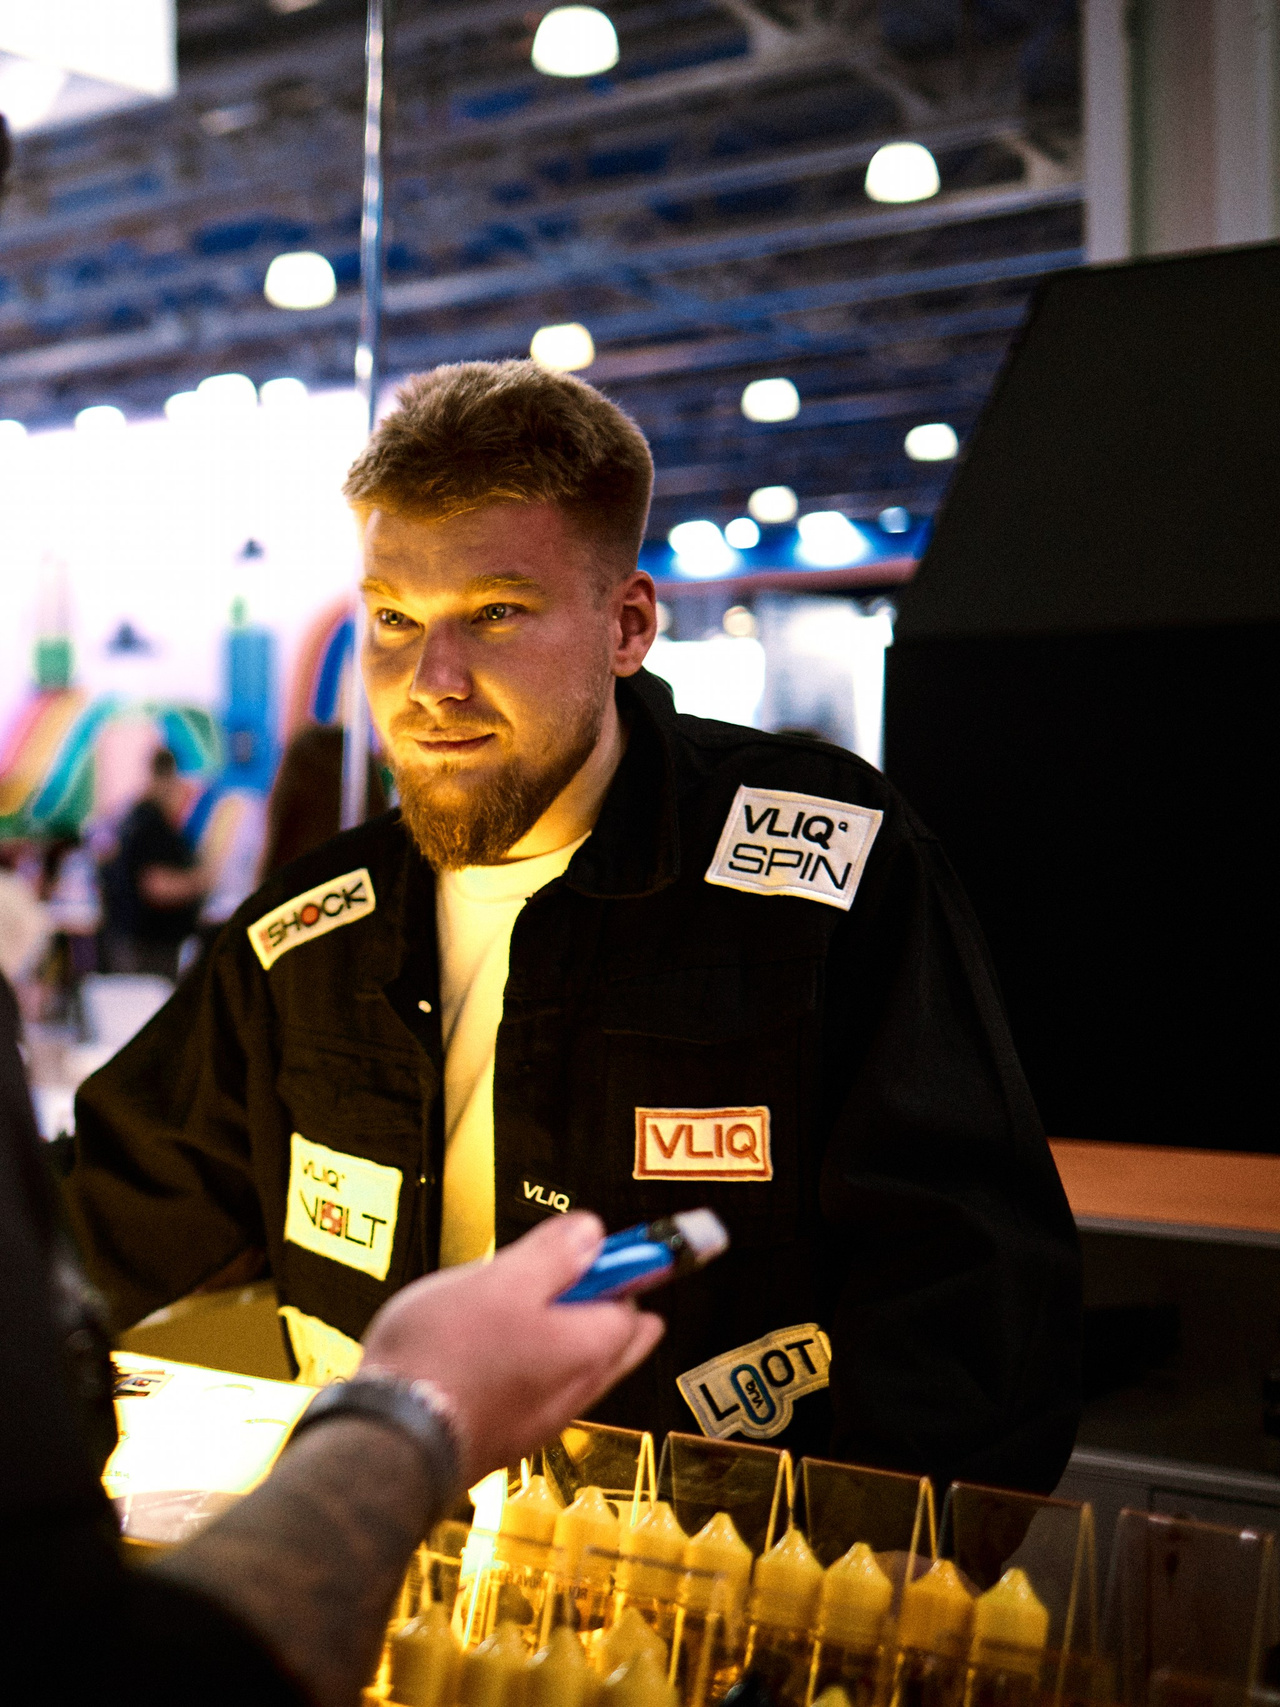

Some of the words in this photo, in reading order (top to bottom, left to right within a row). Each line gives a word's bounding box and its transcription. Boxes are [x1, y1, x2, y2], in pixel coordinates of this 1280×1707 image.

[744, 804, 835, 850] VLIQ
[728, 842, 852, 890] SPIN
[267, 881, 367, 948] SHOCK
[649, 1122, 761, 1164] VLIQ
[299, 1189, 387, 1248] VOLT
[523, 1180, 570, 1214] VLIQ
[699, 1338, 818, 1426] LOOT
